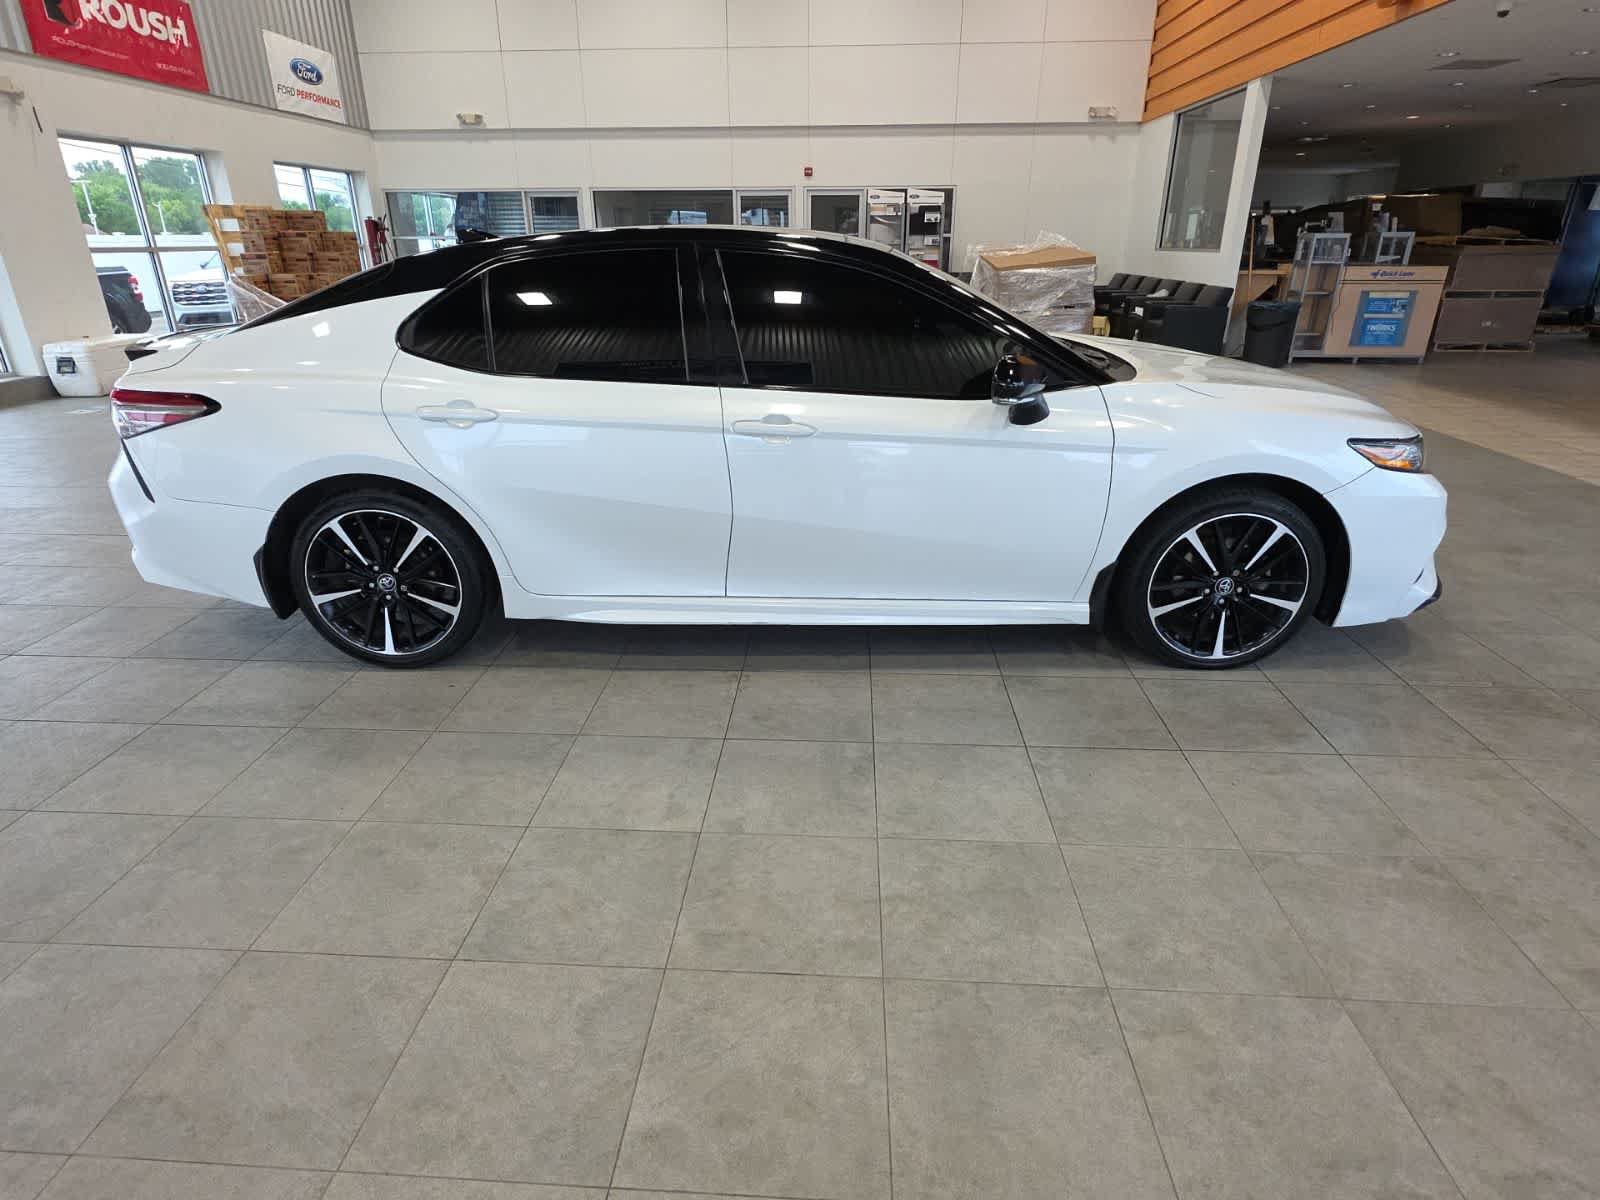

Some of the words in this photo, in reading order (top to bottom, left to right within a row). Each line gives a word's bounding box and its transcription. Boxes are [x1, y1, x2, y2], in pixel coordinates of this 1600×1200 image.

[77, 0, 191, 48] ROUSH
[297, 62, 318, 82] Ford
[277, 83, 296, 97] FORD
[296, 88, 343, 109] PERFORMANCE
